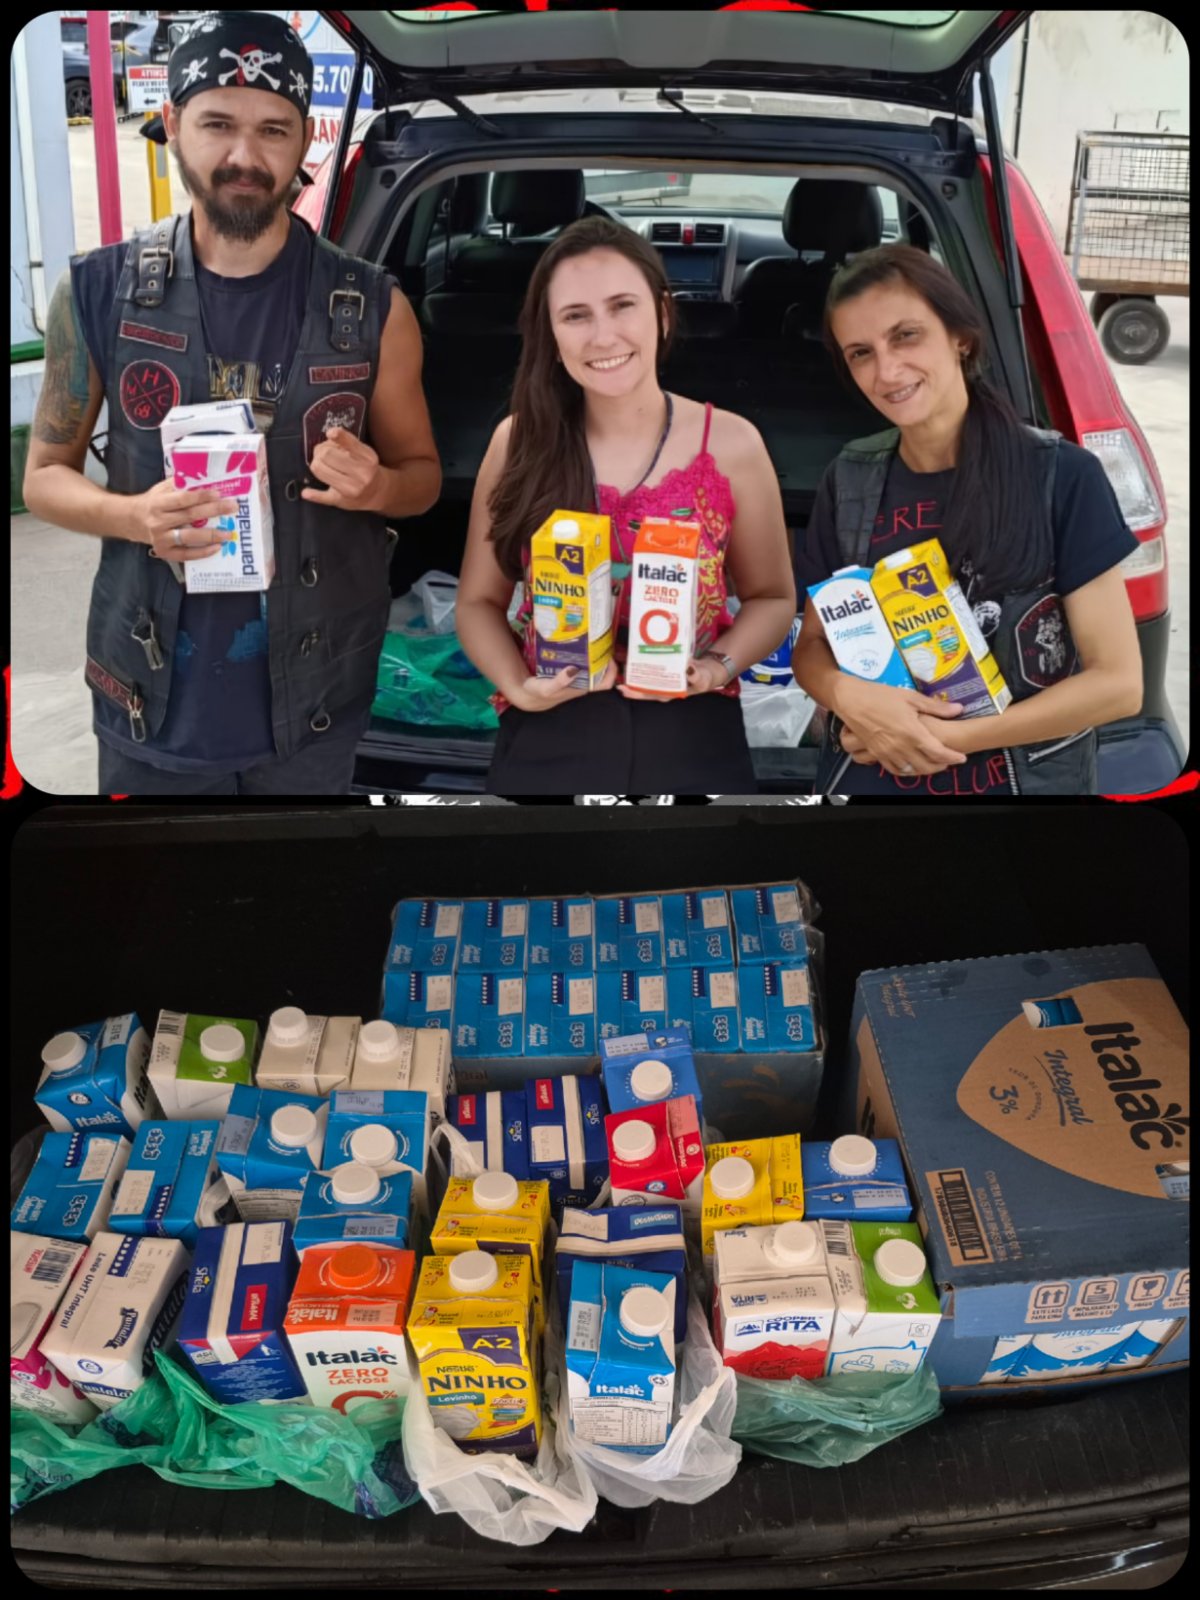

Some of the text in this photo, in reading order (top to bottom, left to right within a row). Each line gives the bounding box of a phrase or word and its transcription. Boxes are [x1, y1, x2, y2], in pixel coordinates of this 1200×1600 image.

[313, 65, 374, 95] 5.700
[236, 497, 258, 576] parmalat
[559, 548, 580, 564] A2
[638, 563, 687, 583] Italac
[906, 570, 929, 588] A2
[535, 577, 585, 598] NINHO
[644, 584, 679, 598] ZERO
[820, 597, 873, 624] Italac
[892, 604, 950, 636] NINHO
[1043, 1049, 1094, 1126] Integral
[1083, 1021, 1176, 1151] Italac
[989, 1085, 1019, 1115] 3%
[76, 1112, 122, 1128] Italac
[81, 1274, 96, 1293] UHT
[192, 1266, 208, 1294] Shefa
[1094, 1283, 1107, 1295] 5
[59, 1293, 83, 1330] Integral
[288, 1306, 339, 1325] Italac
[765, 1320, 821, 1333] RITA
[472, 1338, 513, 1350] A2
[306, 1349, 399, 1367] Italac
[326, 1368, 389, 1380] ZERO
[329, 1378, 388, 1386] LACTOSE
[427, 1374, 528, 1393] NINHO
[438, 1392, 477, 1403] Levinho
[596, 1384, 645, 1396] Italac
